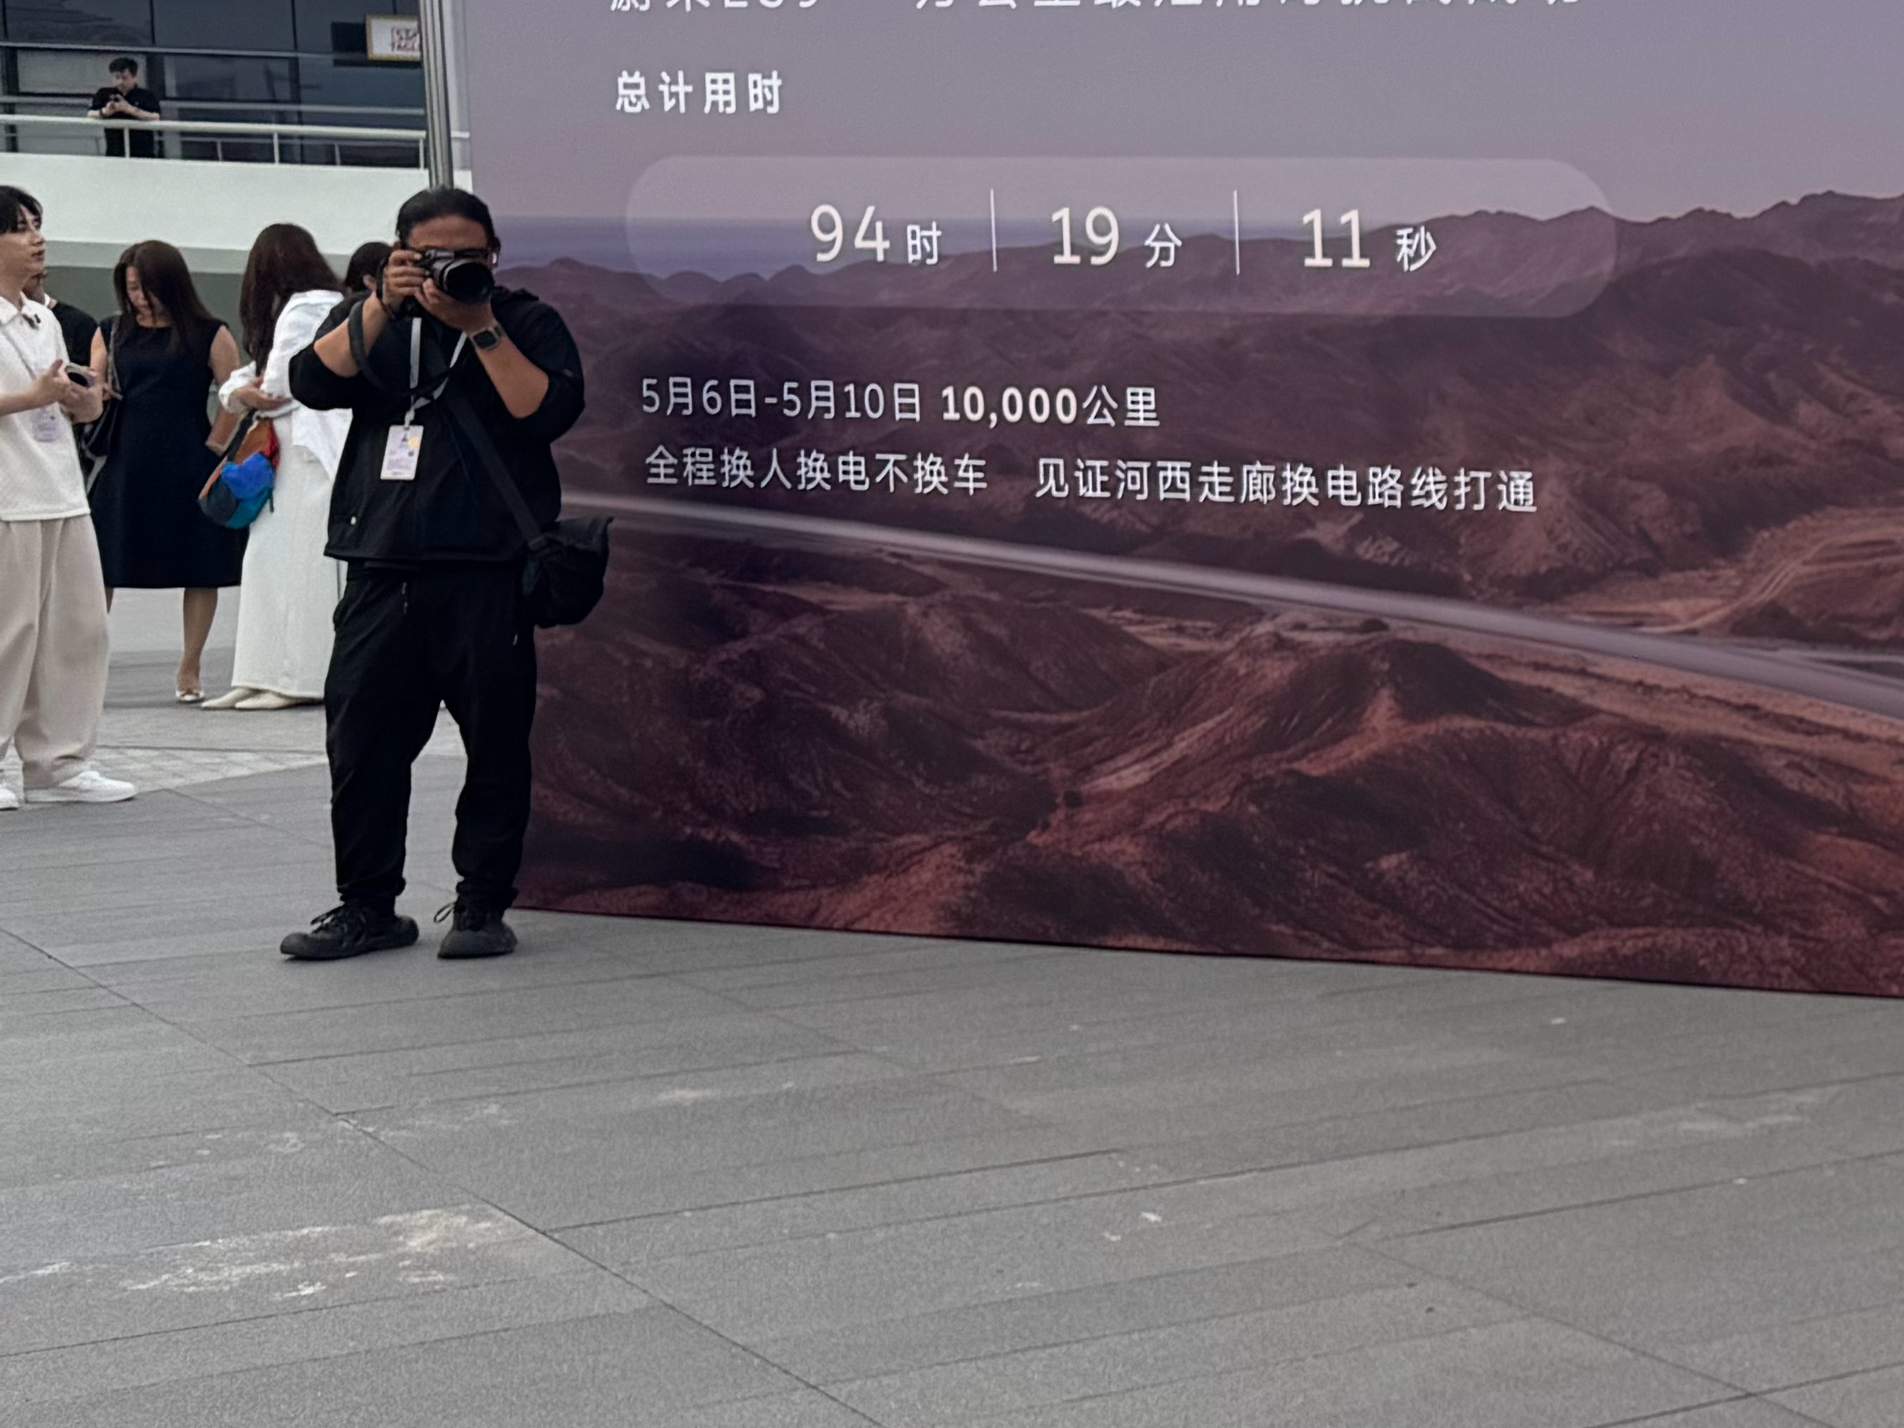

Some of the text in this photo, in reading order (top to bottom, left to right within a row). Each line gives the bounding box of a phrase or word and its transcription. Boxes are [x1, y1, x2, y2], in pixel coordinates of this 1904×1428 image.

[616, 71, 782, 113] 总计用时
[643, 377, 1159, 428] 5月6日-5月10日 10,000公里
[646, 446, 1537, 512] 全程换人换电不换车 见证河西走廊换电路线打通
